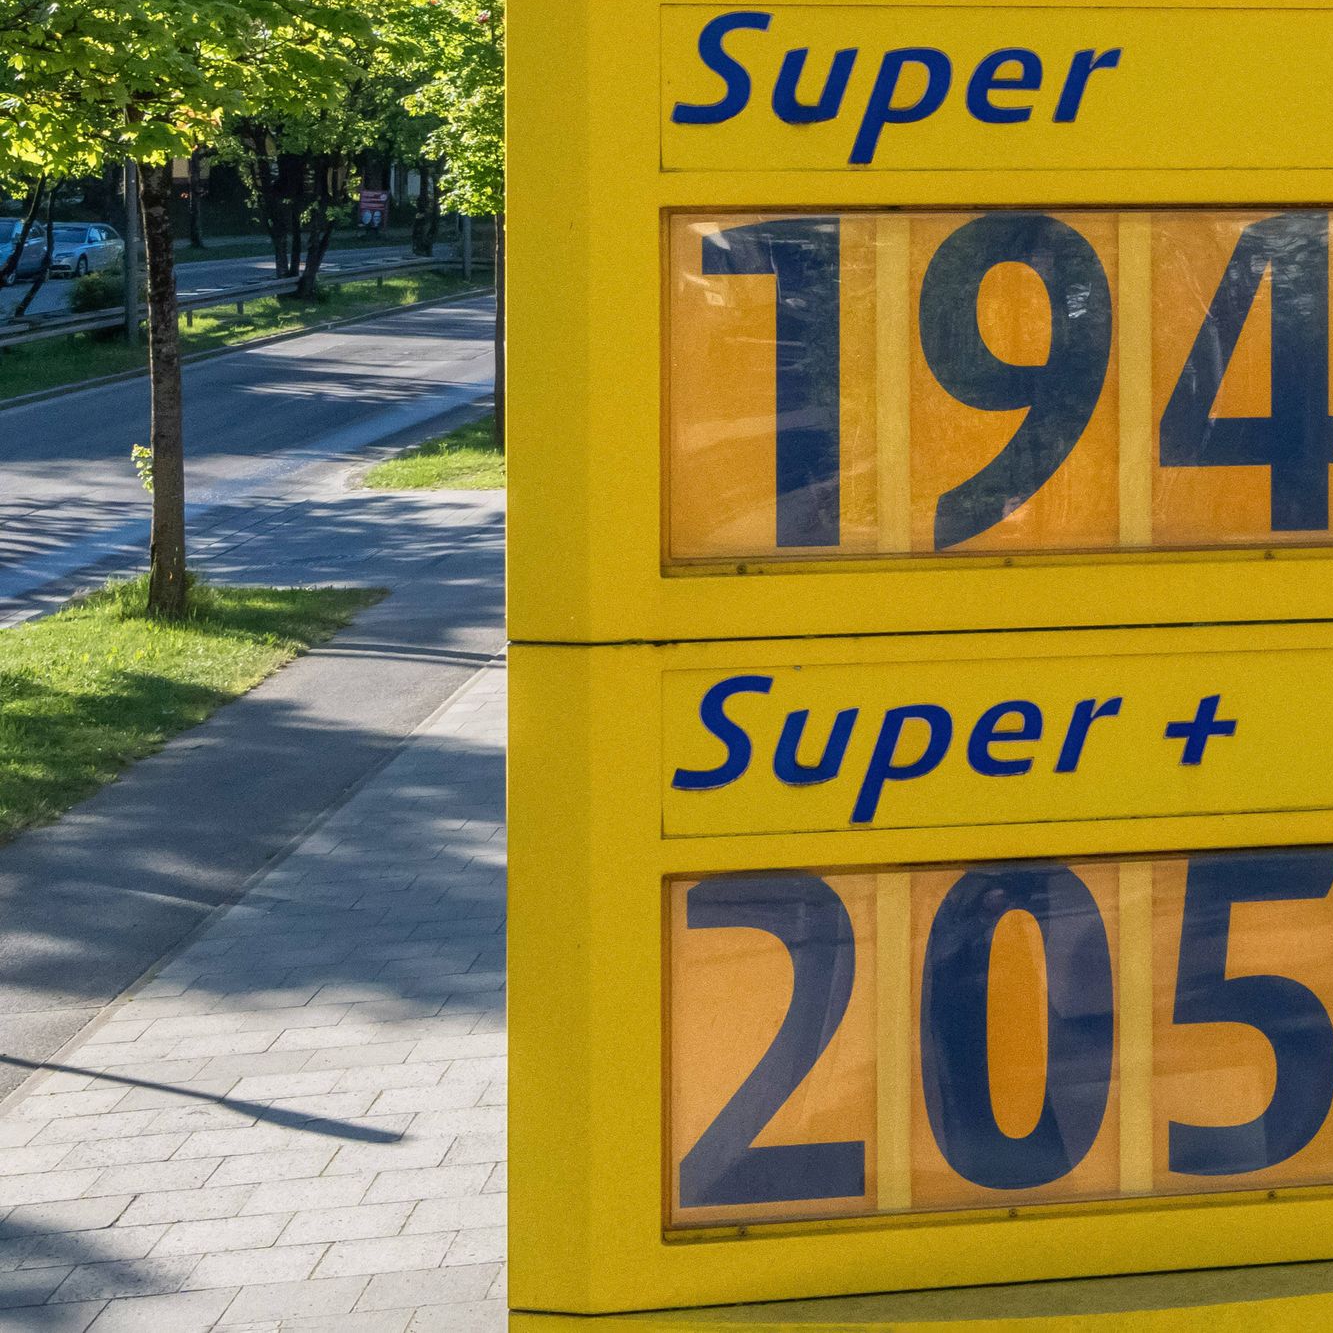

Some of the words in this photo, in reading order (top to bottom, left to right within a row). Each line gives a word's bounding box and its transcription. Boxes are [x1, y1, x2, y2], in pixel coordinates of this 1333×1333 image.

[670, 10, 1122, 165] Super
[670, 674, 1123, 826] Super
[1163, 694, 1238, 766] +
